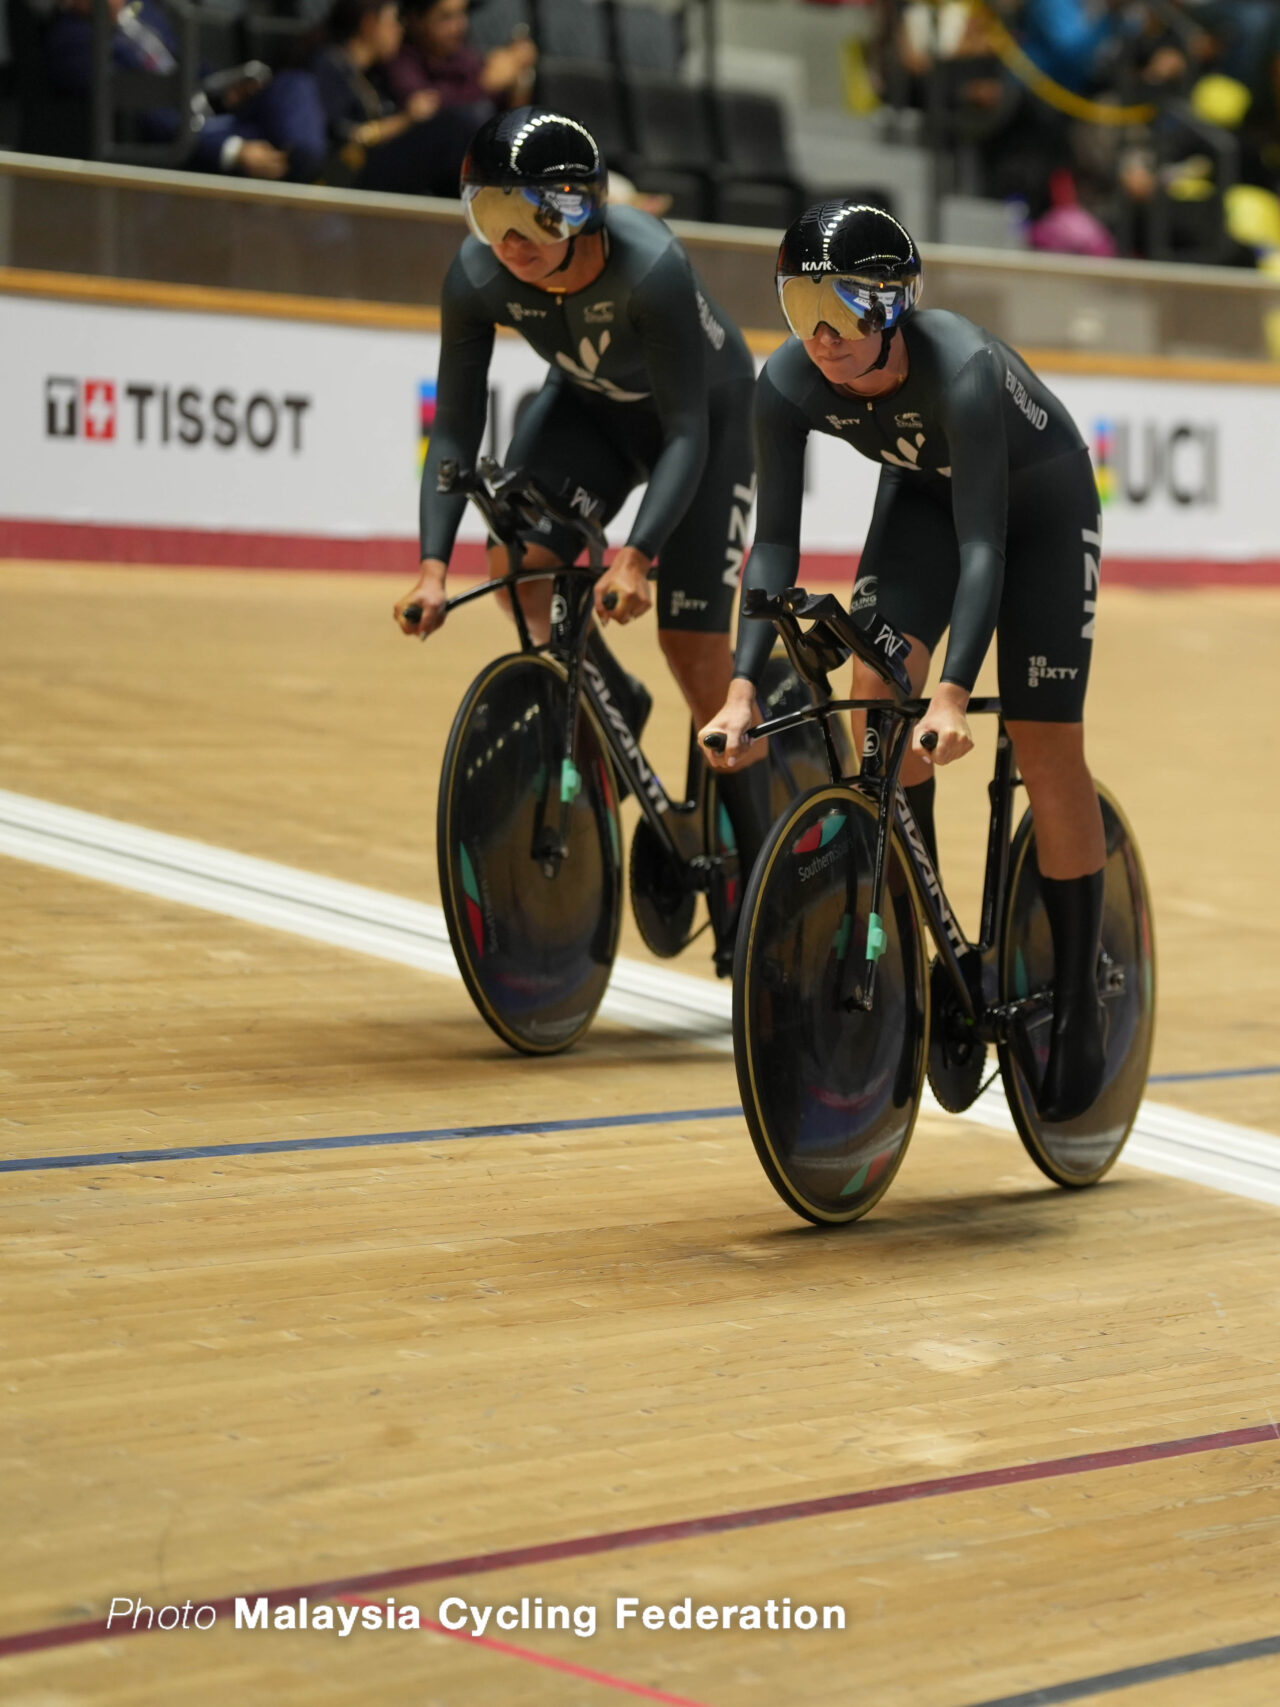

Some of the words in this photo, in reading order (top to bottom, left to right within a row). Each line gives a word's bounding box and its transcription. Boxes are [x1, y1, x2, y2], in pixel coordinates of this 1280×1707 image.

[801, 261, 832, 272] KASK
[126, 381, 312, 453] TISSOT
[1013, 380, 1048, 431] ZEALAND
[1116, 419, 1219, 509] UCI
[1028, 656, 1047, 667] 18
[1028, 667, 1079, 680] SIXTY
